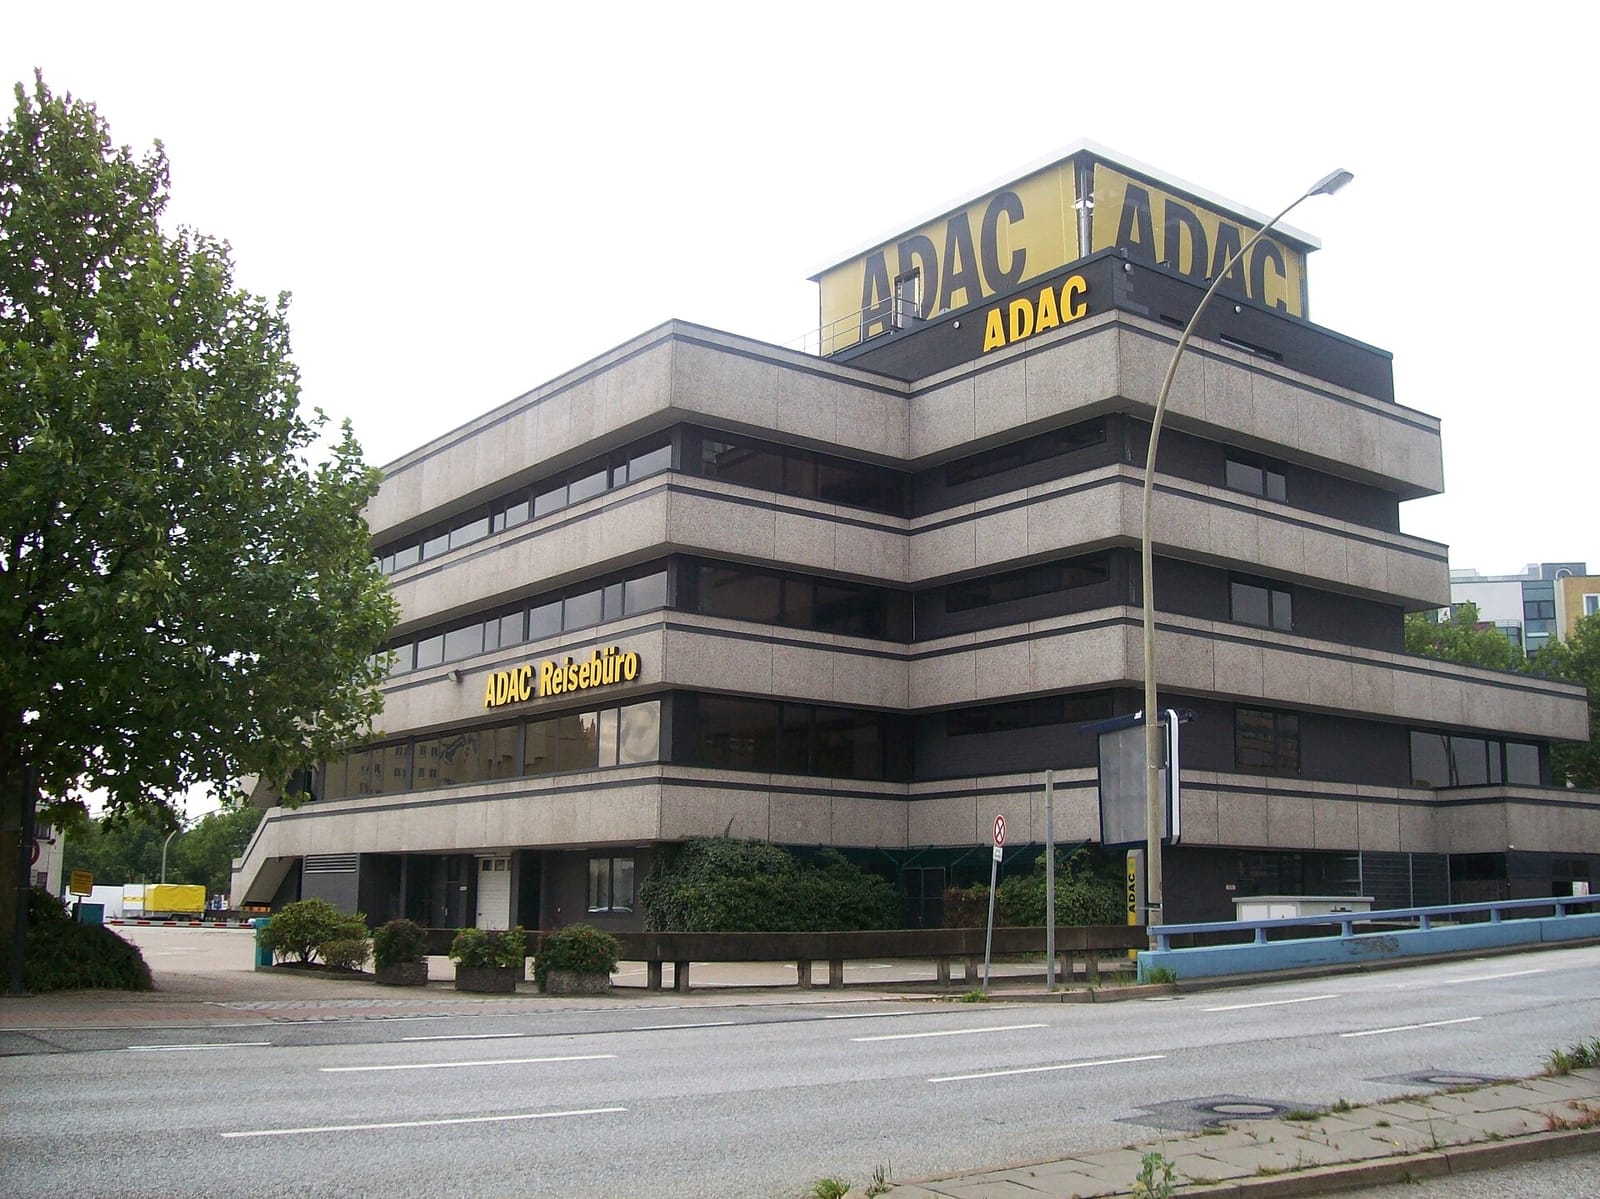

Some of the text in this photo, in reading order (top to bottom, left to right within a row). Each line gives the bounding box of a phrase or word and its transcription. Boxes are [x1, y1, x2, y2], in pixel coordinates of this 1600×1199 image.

[862, 190, 1027, 336] ADAC
[1115, 182, 1287, 314] ADAC
[982, 274, 1088, 353] ADAC
[485, 647, 639, 708] ADAC Reisebüro
[1128, 873, 1136, 914] ADAC
